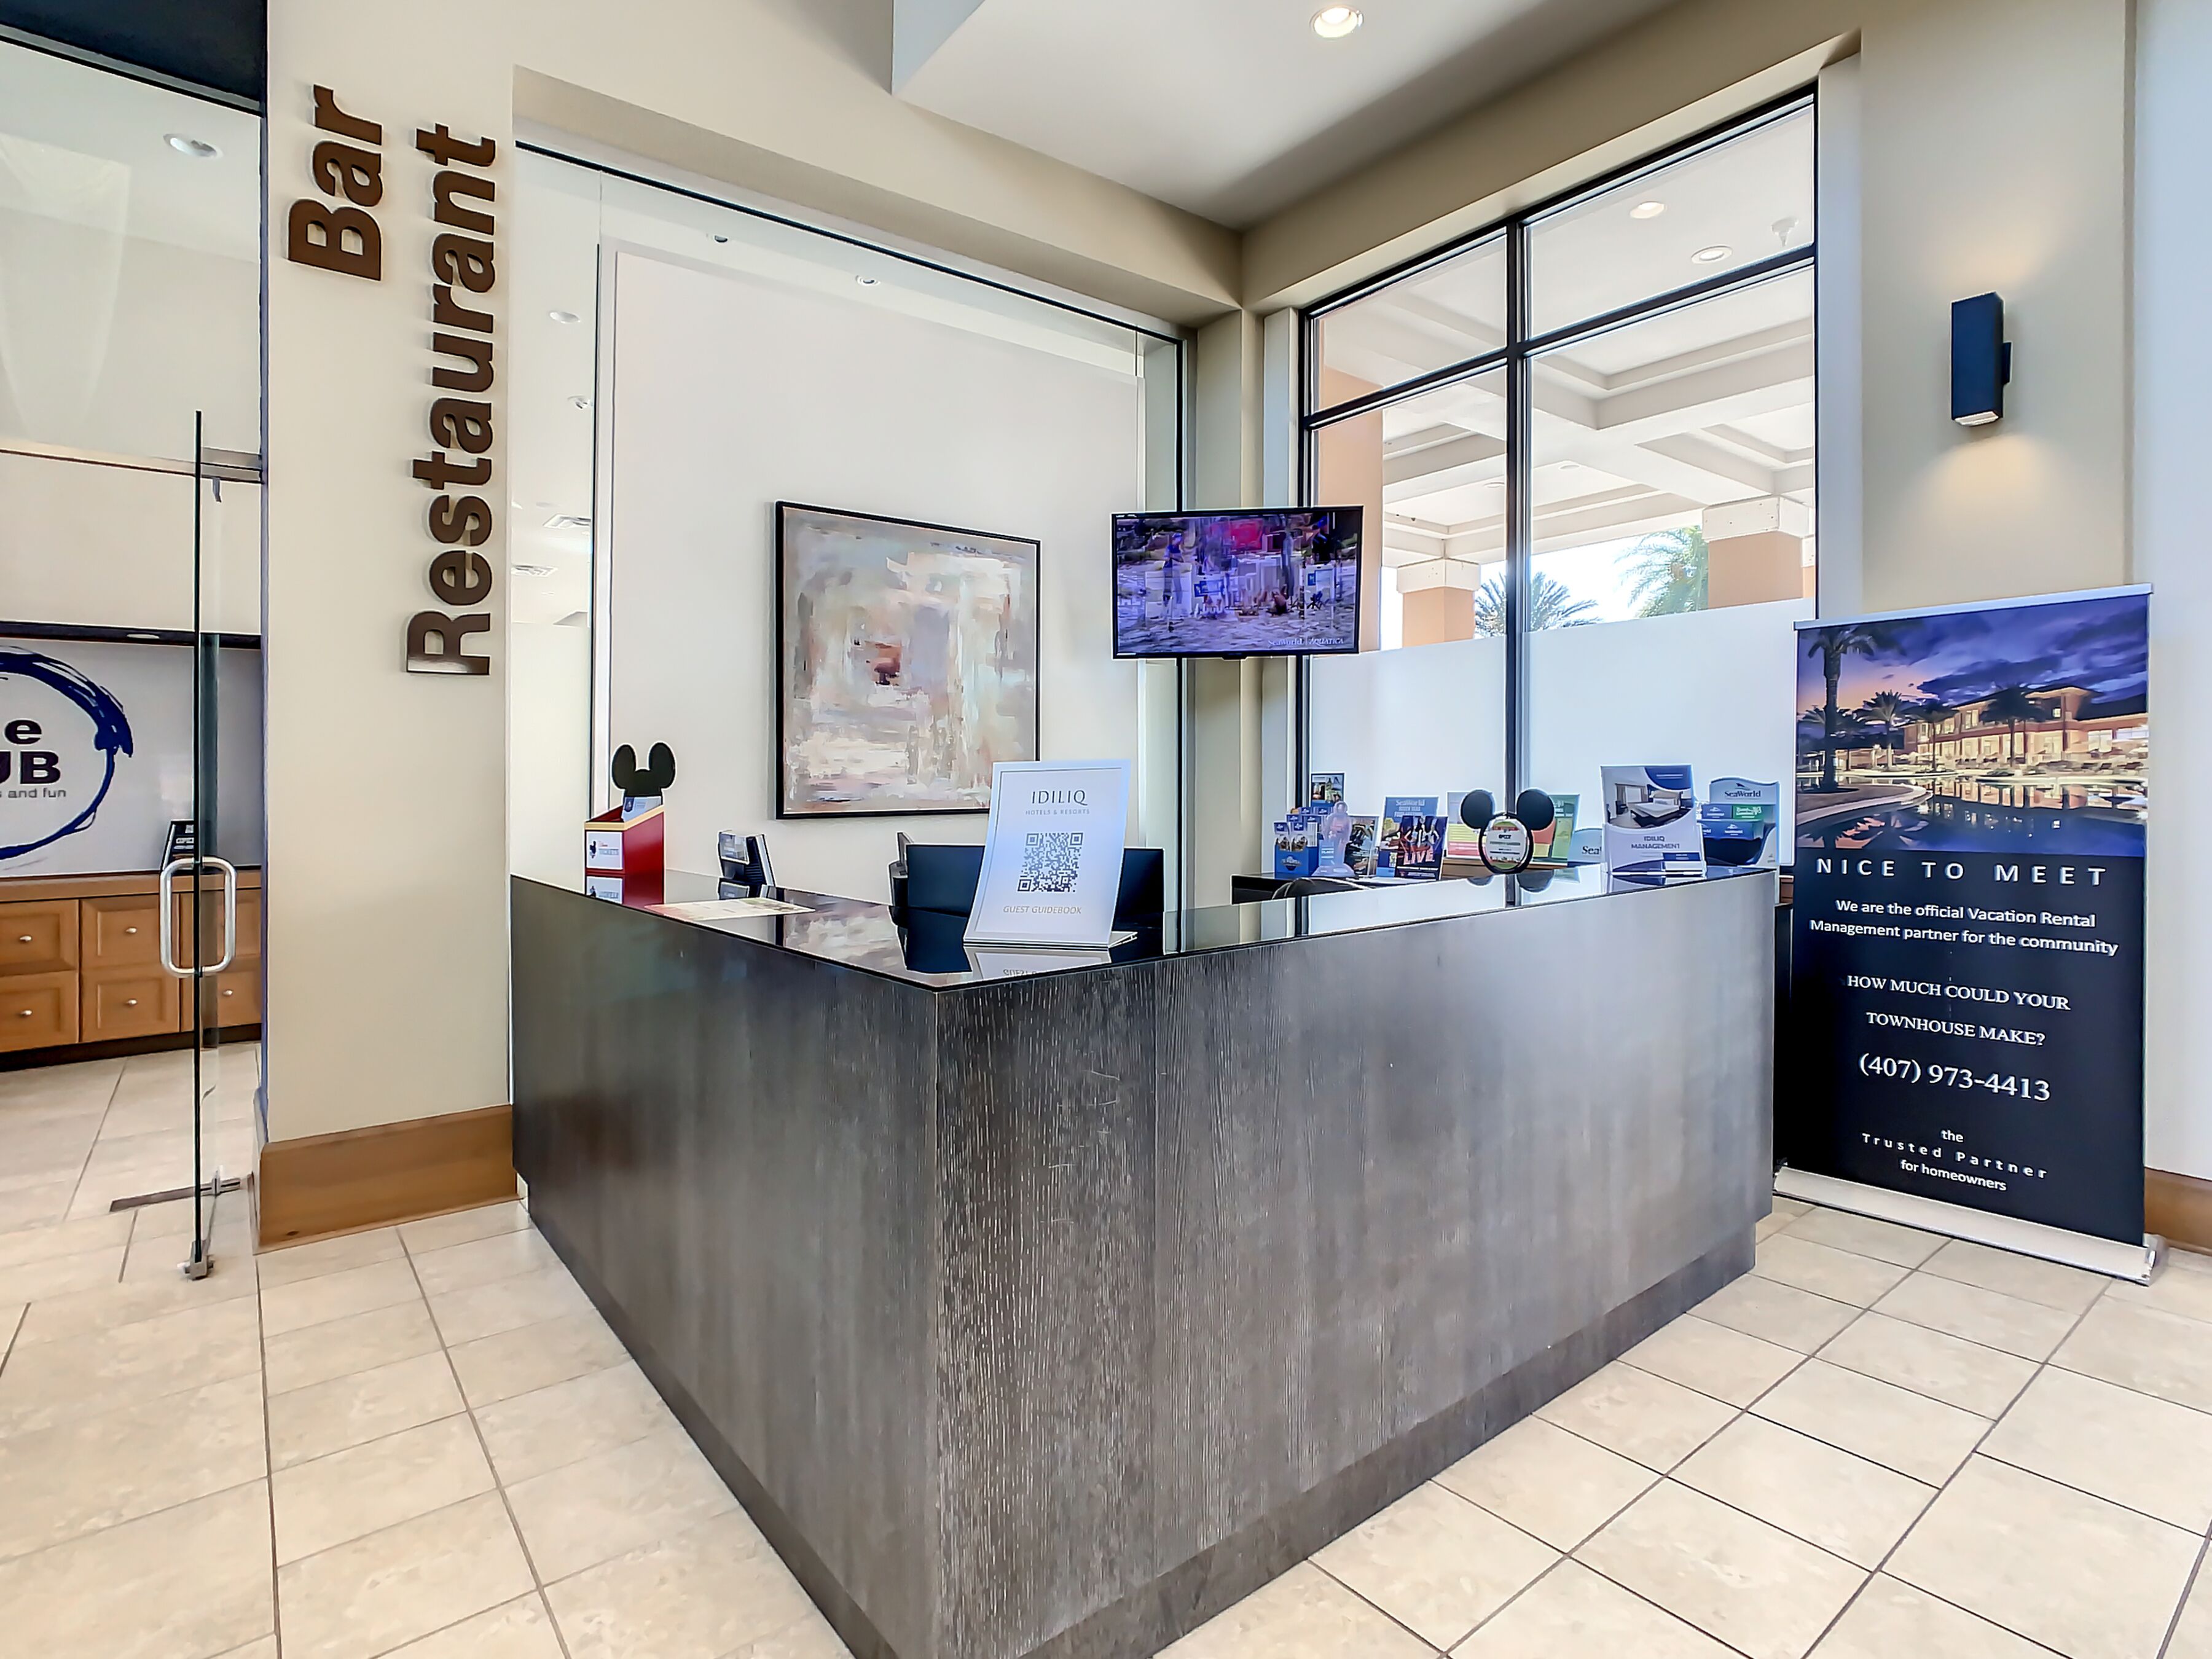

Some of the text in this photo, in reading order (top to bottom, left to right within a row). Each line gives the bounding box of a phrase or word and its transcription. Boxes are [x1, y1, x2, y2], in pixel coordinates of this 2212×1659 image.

[288, 84, 382, 281] Bar
[407, 124, 495, 675] Restaurant
[0, 751, 61, 784] B
[8, 788, 37, 798] and
[43, 788, 66, 798] fun
[1032, 790, 1088, 806] IDILIQ
[1403, 850, 1435, 865] LIVE
[1582, 845, 1601, 855] Sea
[1818, 859, 2105, 885] NICE TO MEET
[1837, 900, 2095, 927] We are the official Vacation Rental
[1811, 920, 2118, 956] Management partner for the community
[1848, 976, 2071, 1010] HOW MUCH COULD YOUR
[1867, 1013, 2045, 1045] TOWNHOUSE MAKE?
[1861, 1053, 2049, 1100] (407) 973-4413
[1942, 1130, 1963, 1142] the
[1862, 1133, 2047, 1180] Trusted Partner
[1901, 1160, 2006, 1190] for homeowners
